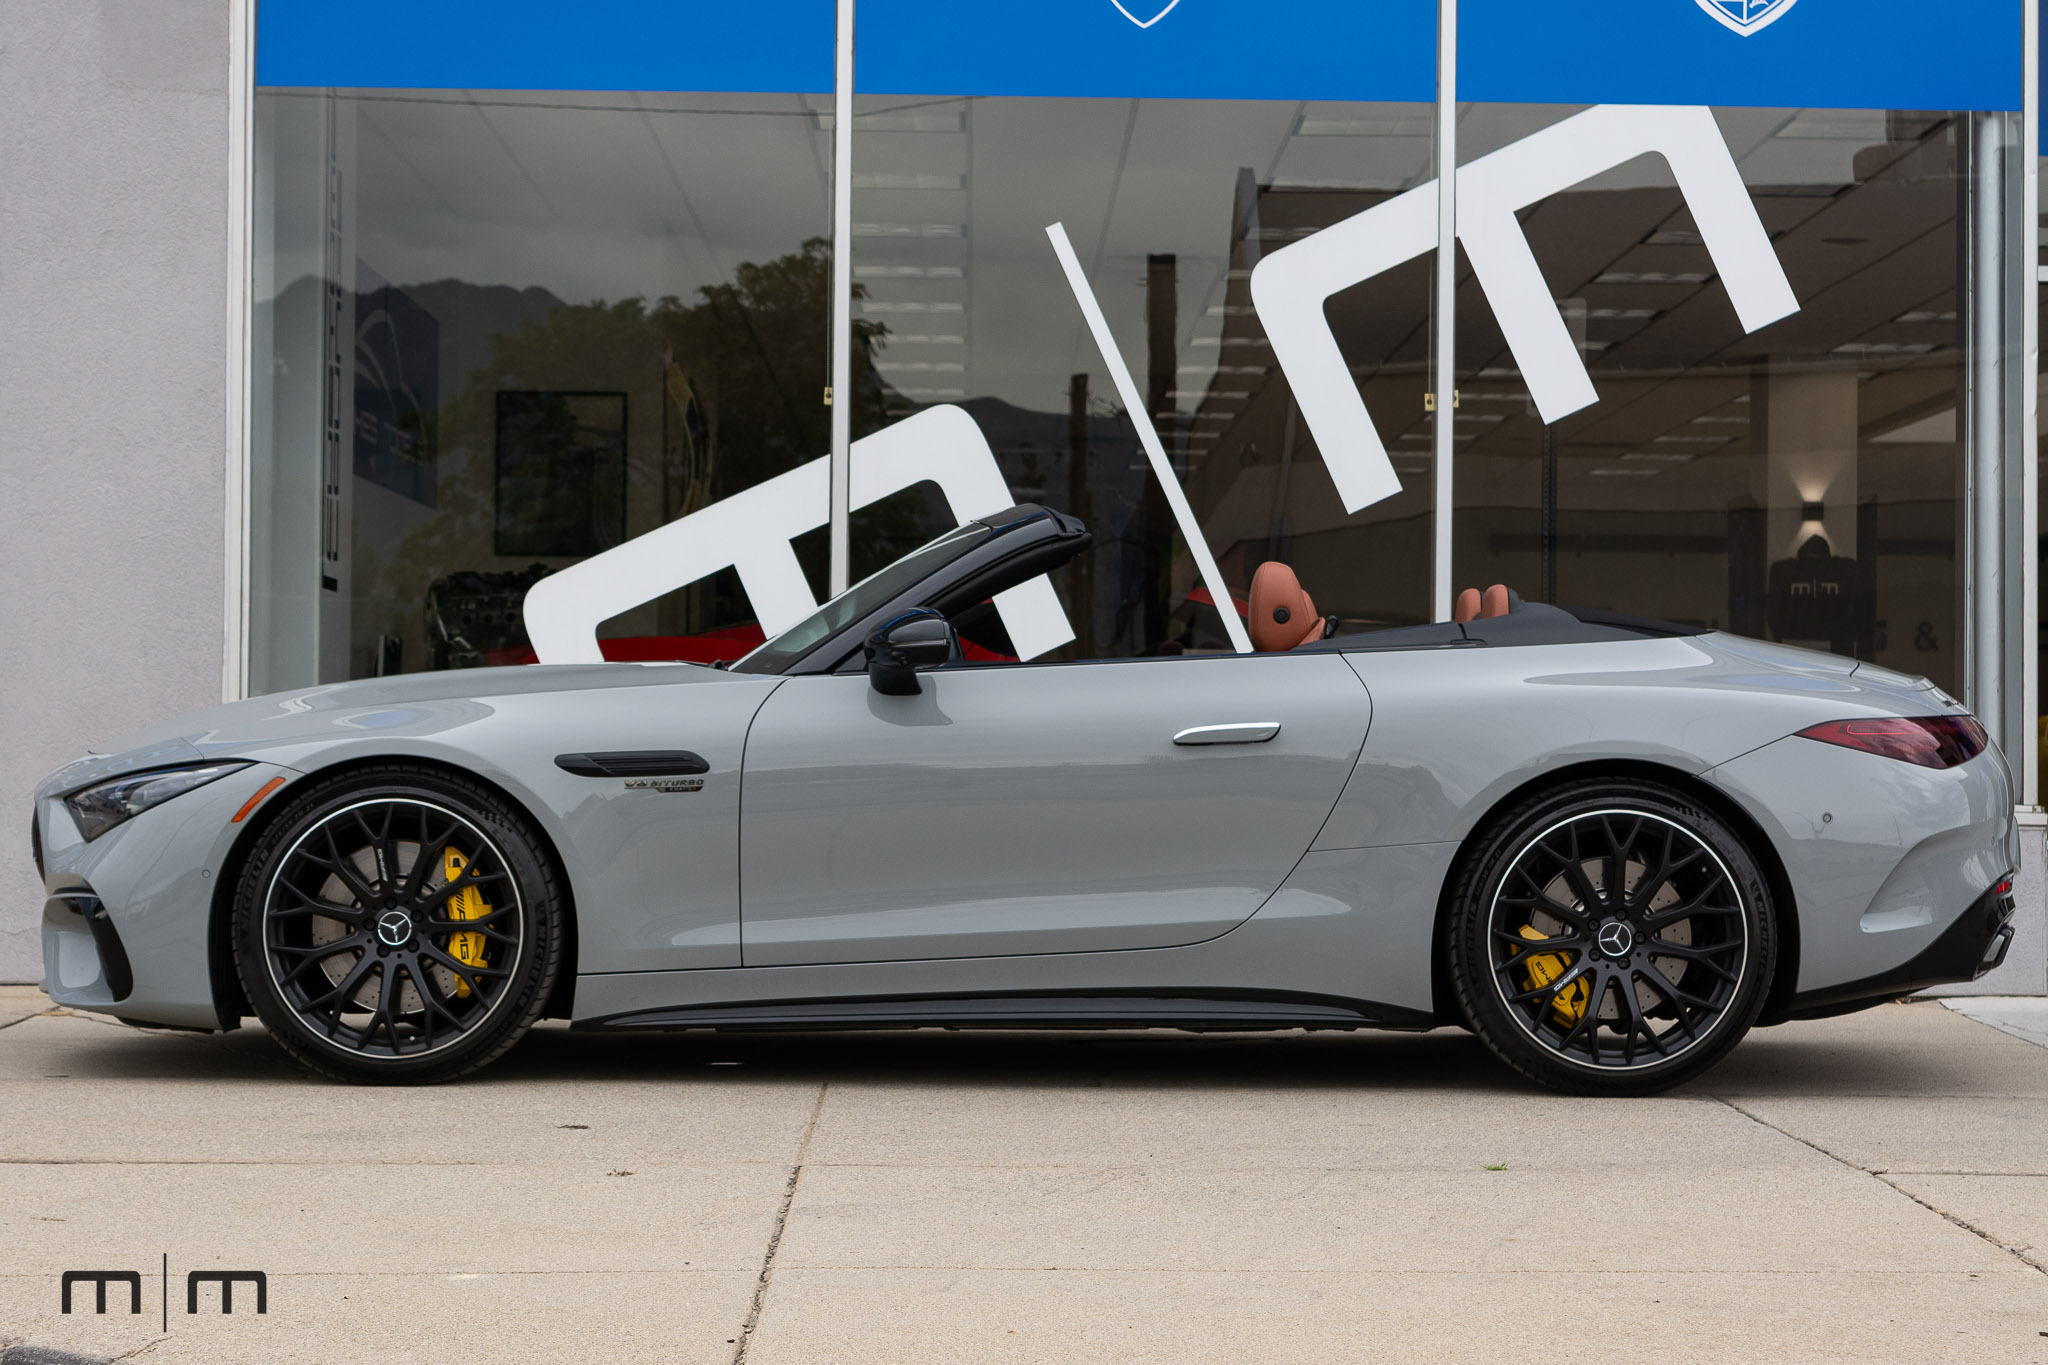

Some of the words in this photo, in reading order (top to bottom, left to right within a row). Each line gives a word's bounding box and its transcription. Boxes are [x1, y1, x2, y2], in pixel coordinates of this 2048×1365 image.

[650, 779, 704, 787] BITURBO
[240, 847, 270, 931] MICHELIN
[1755, 899, 1768, 976] MICHELIN
